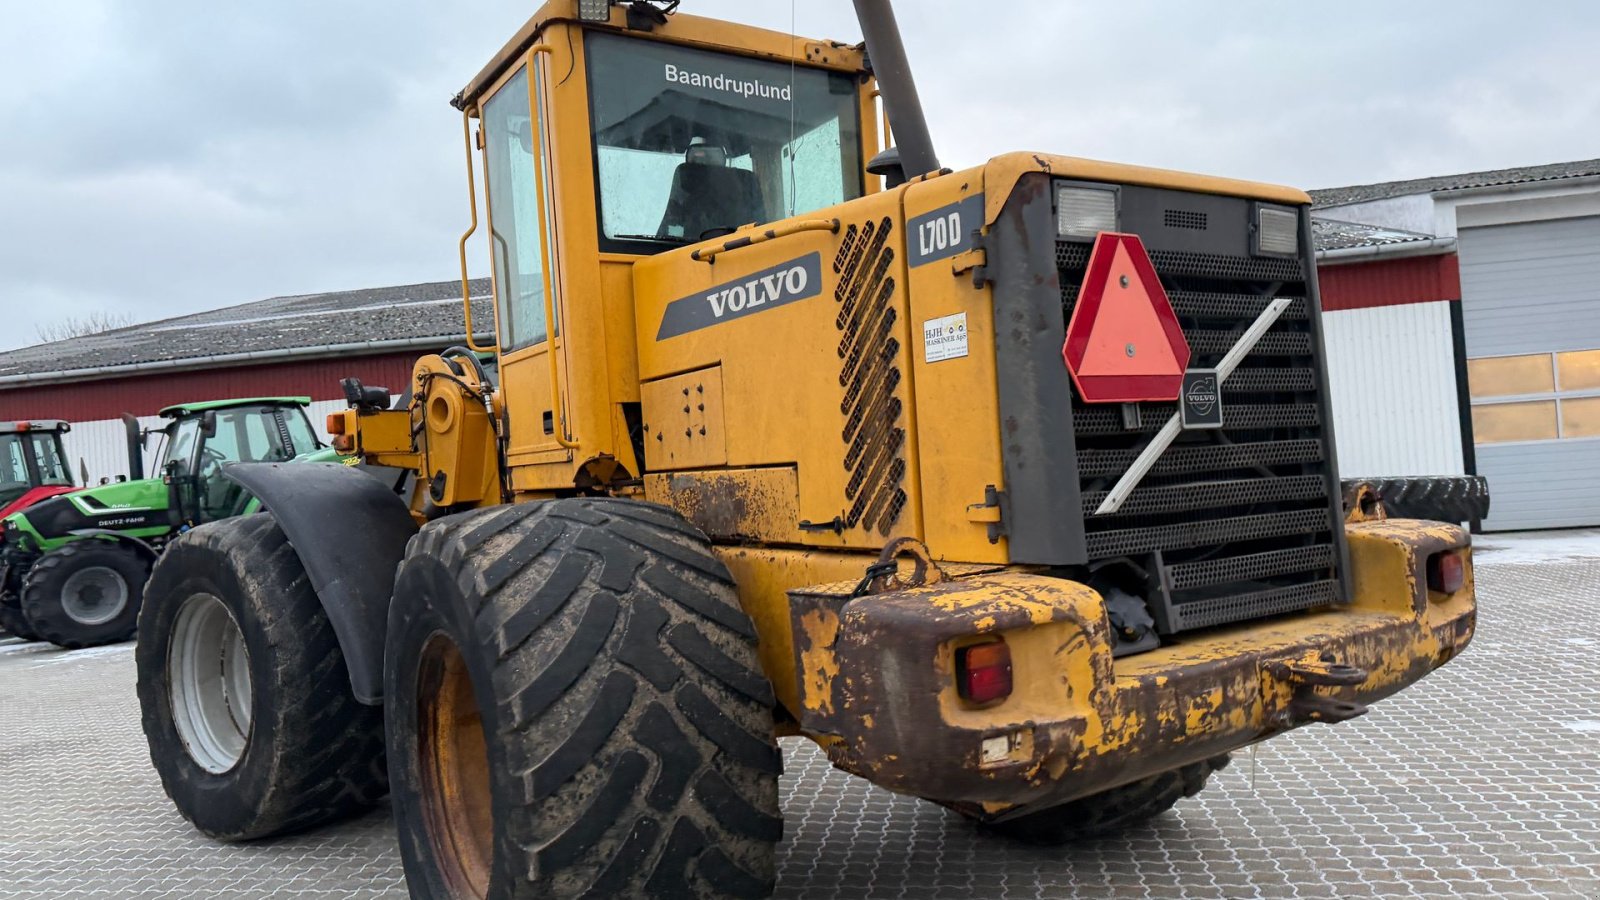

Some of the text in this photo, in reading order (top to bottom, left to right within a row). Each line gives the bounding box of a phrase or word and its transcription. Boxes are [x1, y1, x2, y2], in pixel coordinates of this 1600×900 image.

[665, 64, 791, 101] Baandruplund
[707, 266, 807, 318] VOLVO
[926, 327, 942, 340] HJH
[98, 516, 145, 526] DEUTZ-FAHR
